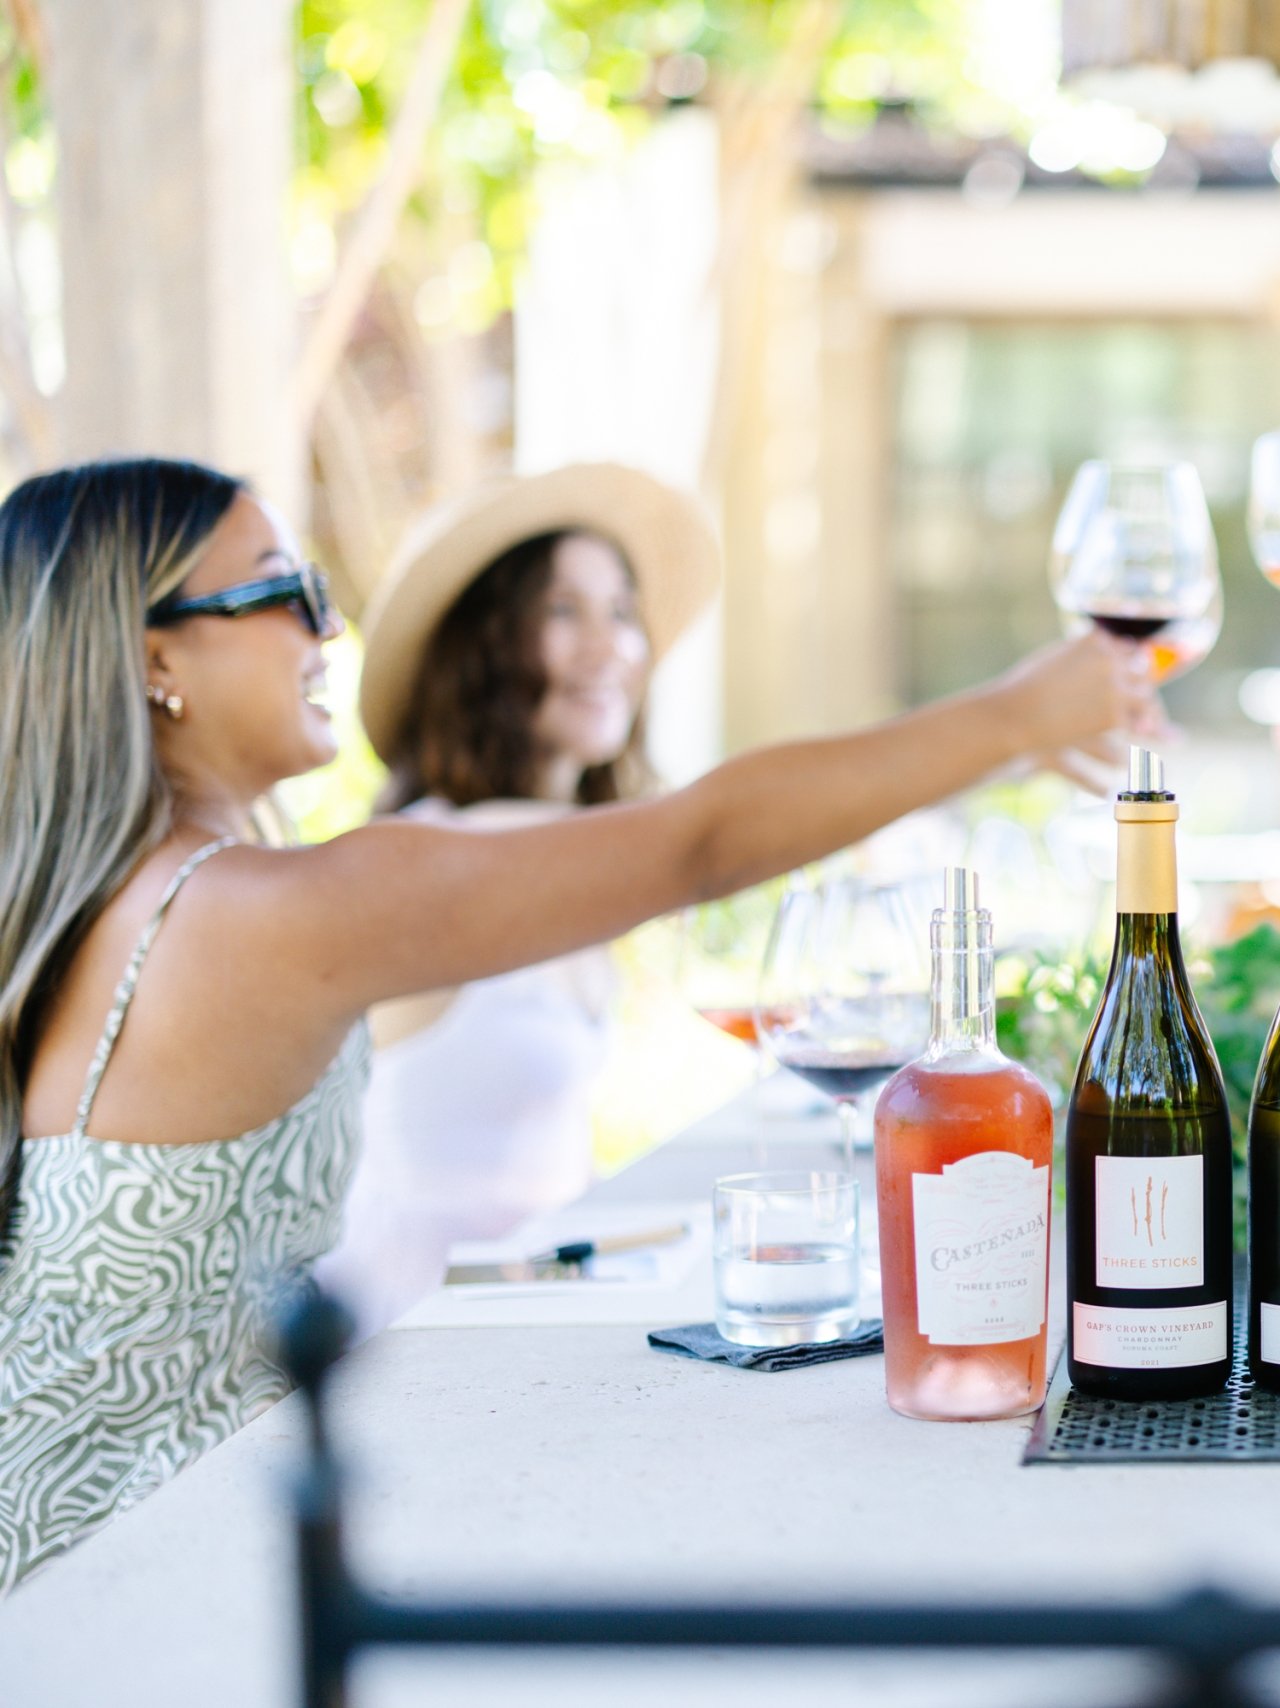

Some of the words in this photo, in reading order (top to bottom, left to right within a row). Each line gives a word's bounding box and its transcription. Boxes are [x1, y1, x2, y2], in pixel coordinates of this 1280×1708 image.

[1102, 1257, 1147, 1269] THREE
[1152, 1256, 1198, 1268] STICKS
[955, 1283, 993, 1291] THREE
[995, 1278, 1028, 1290] STICKS
[1086, 1321, 1112, 1332] GAP'S
[1115, 1324, 1157, 1334] CROWN
[1161, 1321, 1214, 1333] VINEYARD
